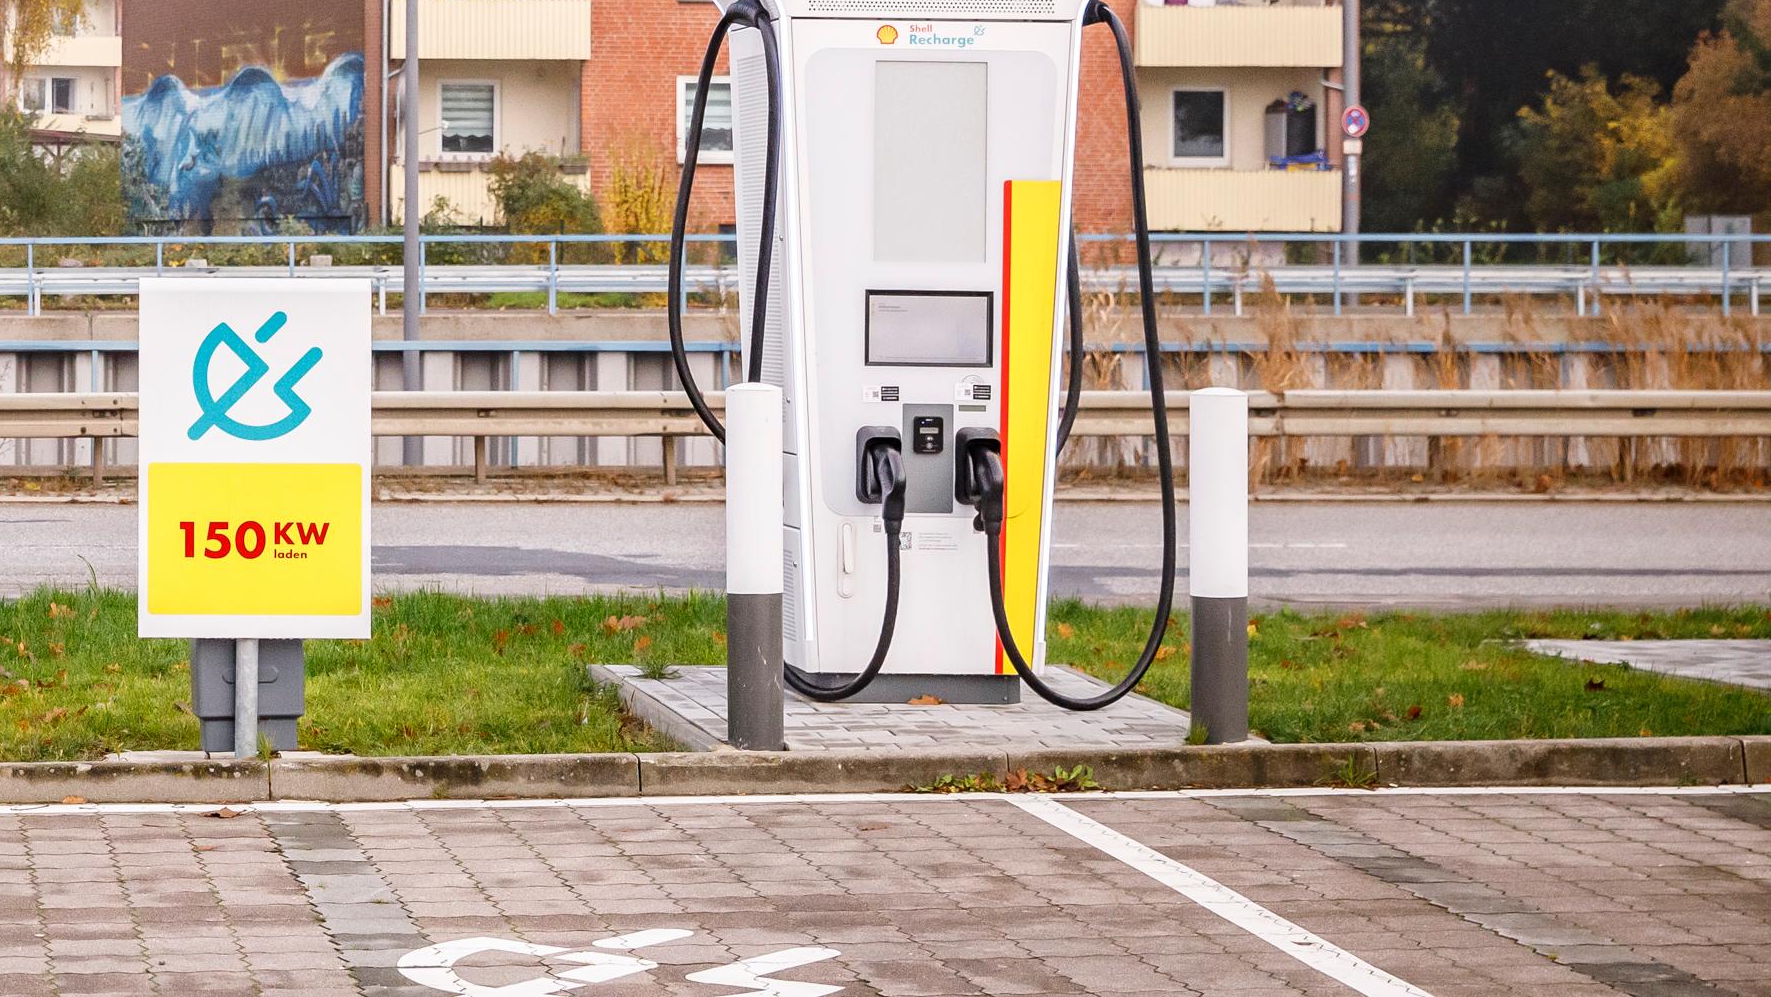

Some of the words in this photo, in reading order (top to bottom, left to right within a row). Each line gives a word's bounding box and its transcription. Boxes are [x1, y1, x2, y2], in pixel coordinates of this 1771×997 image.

[909, 34, 974, 47] Recharge
[179, 520, 266, 559] 150
[273, 522, 330, 545] KW
[273, 549, 308, 559] laden
